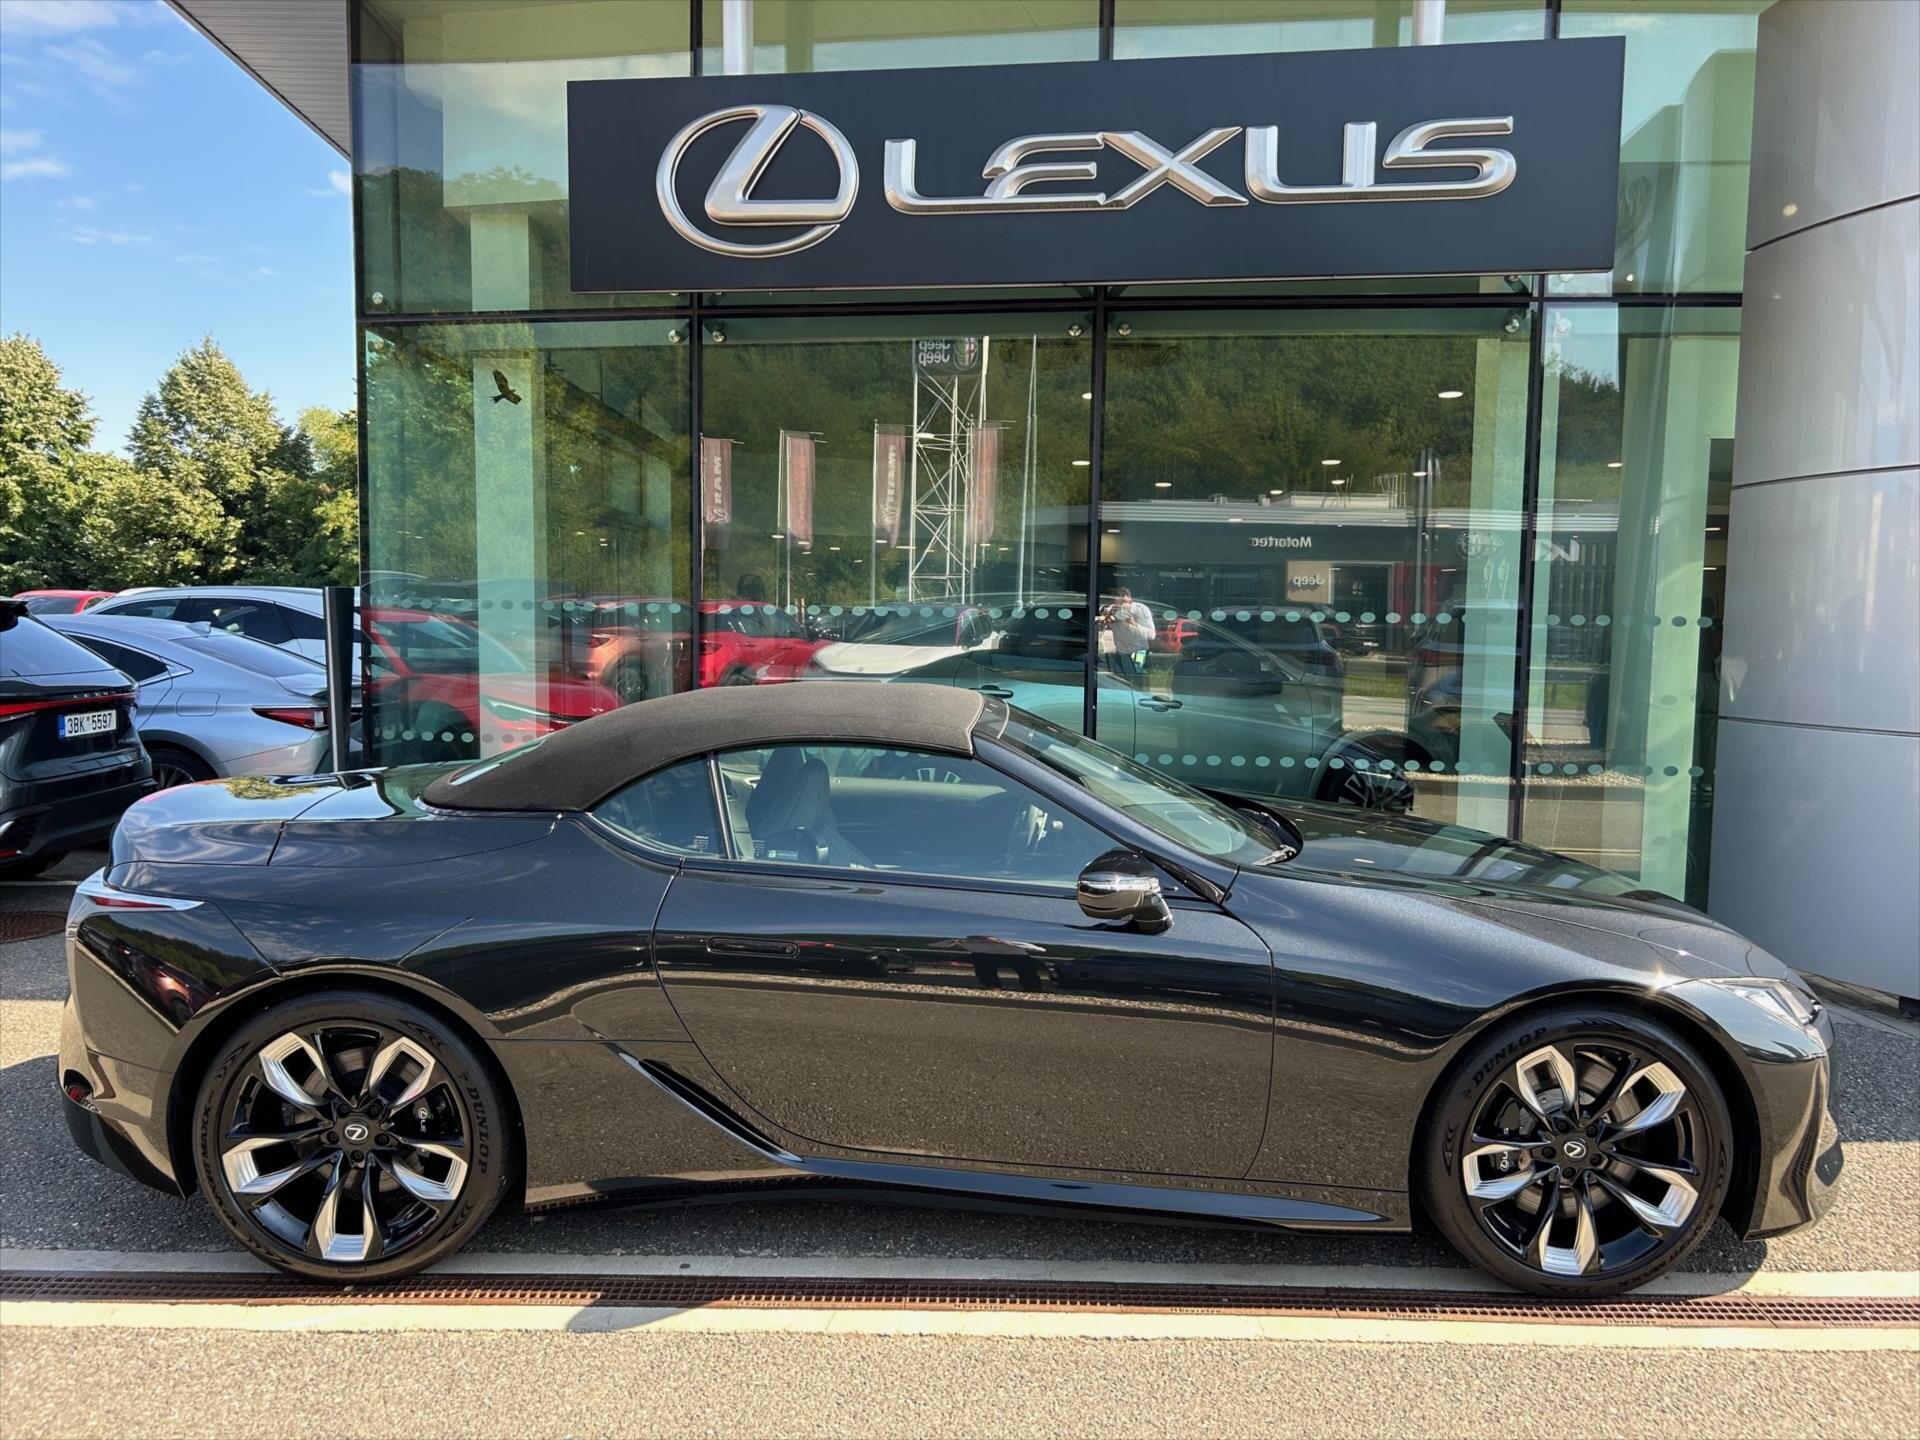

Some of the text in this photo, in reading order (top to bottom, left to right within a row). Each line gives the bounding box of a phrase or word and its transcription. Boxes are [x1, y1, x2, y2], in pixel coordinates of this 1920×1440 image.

[884, 116, 1517, 214] LEXUS
[713, 456, 722, 505] RAM
[67, 716, 85, 734] 3BK
[91, 713, 113, 730] 5597
[1472, 1027, 1547, 1087] DUNLOP
[199, 1103, 211, 1160] MAXX
[466, 1086, 489, 1174] DUNLOP
